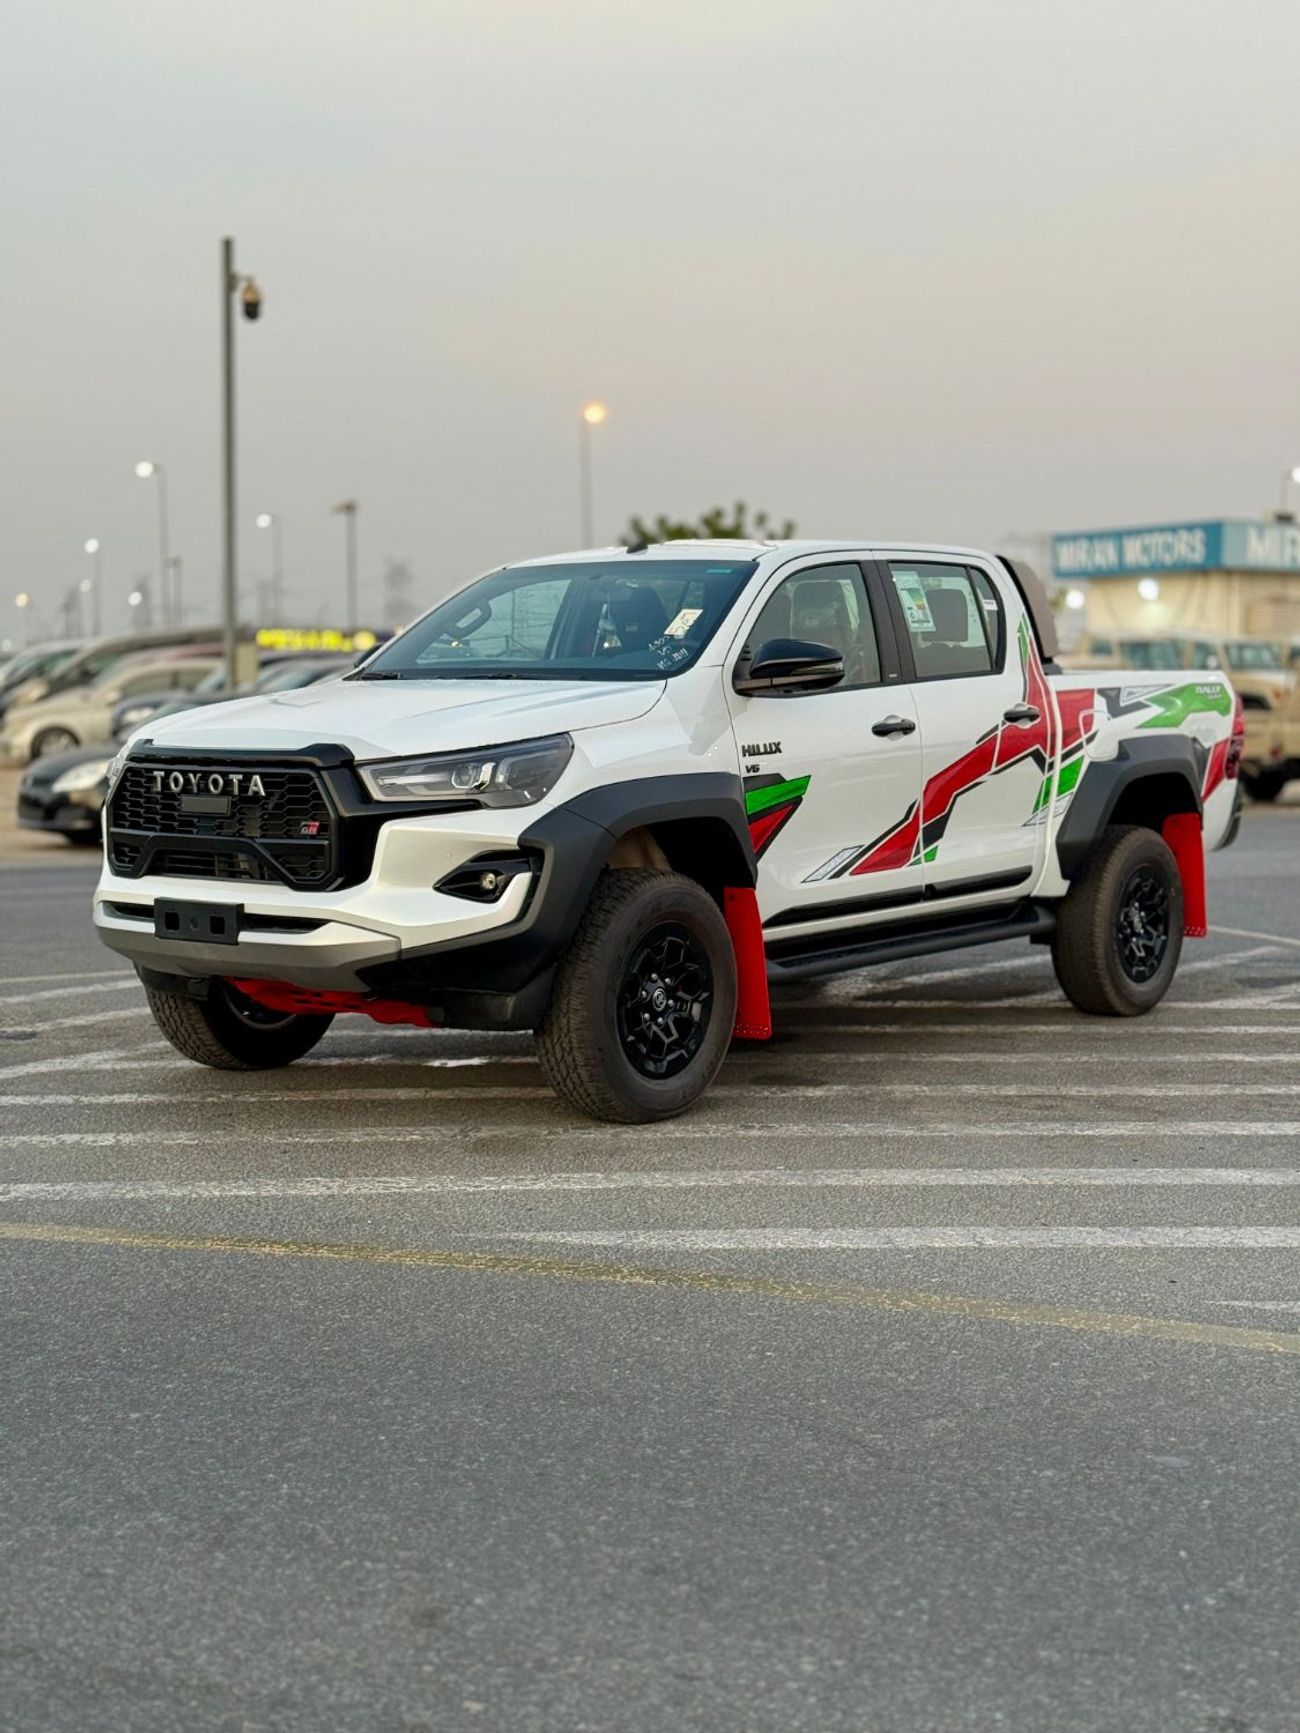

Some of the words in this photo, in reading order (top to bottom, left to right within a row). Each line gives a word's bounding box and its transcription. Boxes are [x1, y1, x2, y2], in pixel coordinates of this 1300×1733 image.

[1058, 539, 1118, 570] MIRAN
[1123, 529, 1206, 567] MOTORS
[741, 741, 782, 758] HILUX
[745, 764, 760, 774] V6
[153, 771, 266, 797] TOYOTA
[301, 821, 320, 835] GR
